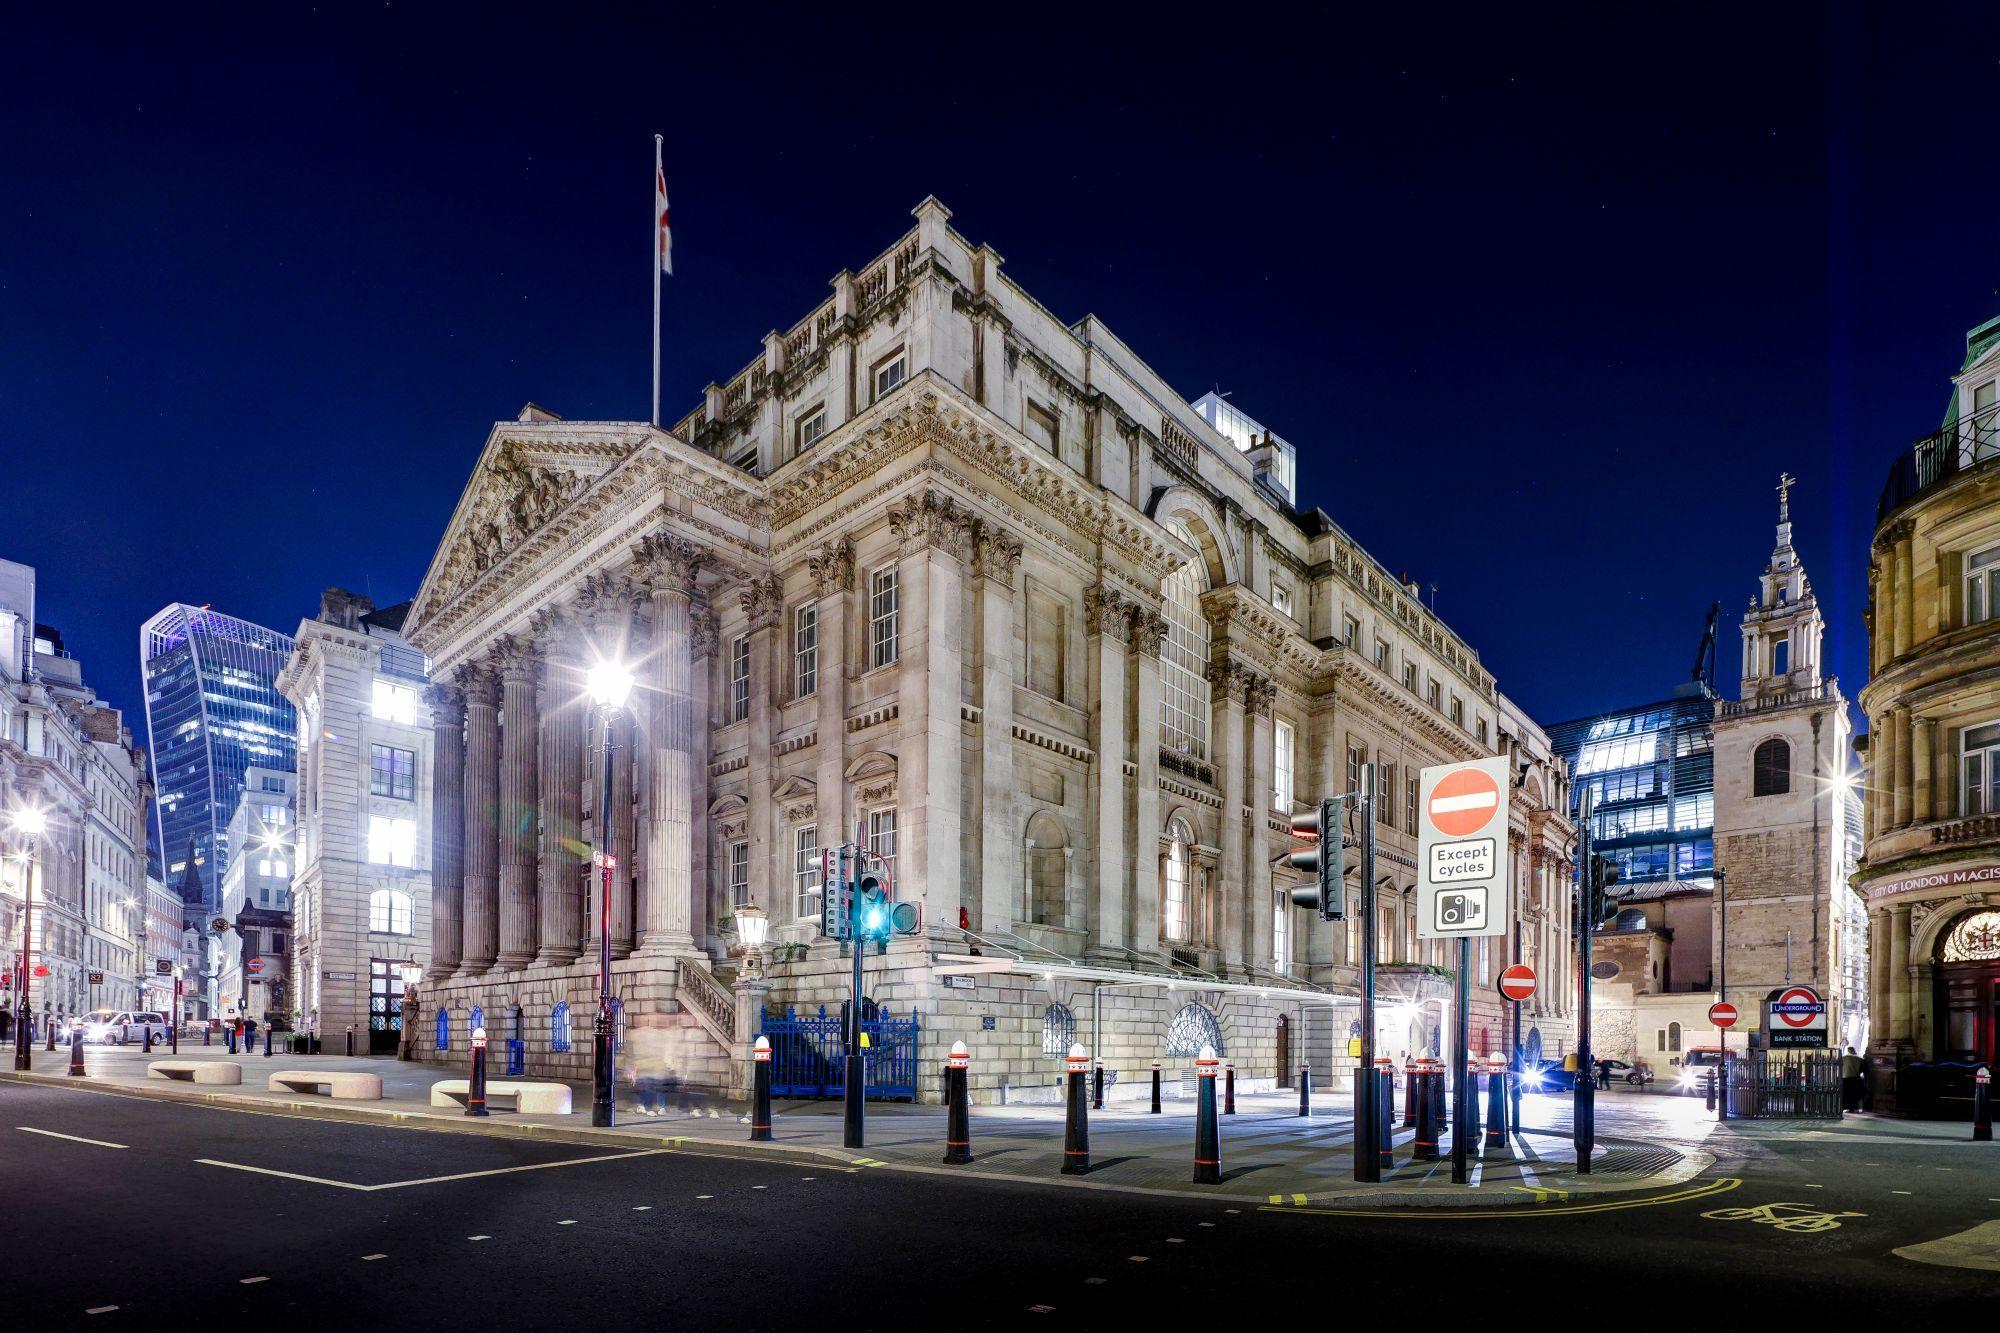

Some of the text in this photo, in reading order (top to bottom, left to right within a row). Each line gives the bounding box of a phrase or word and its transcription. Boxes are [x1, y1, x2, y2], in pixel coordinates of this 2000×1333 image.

[1438, 846, 1488, 860] Except
[1440, 862, 1485, 876] cycles
[1875, 886, 1887, 898] CITY
[1888, 883, 1899, 894] OF
[1901, 875, 1949, 892] LONDON
